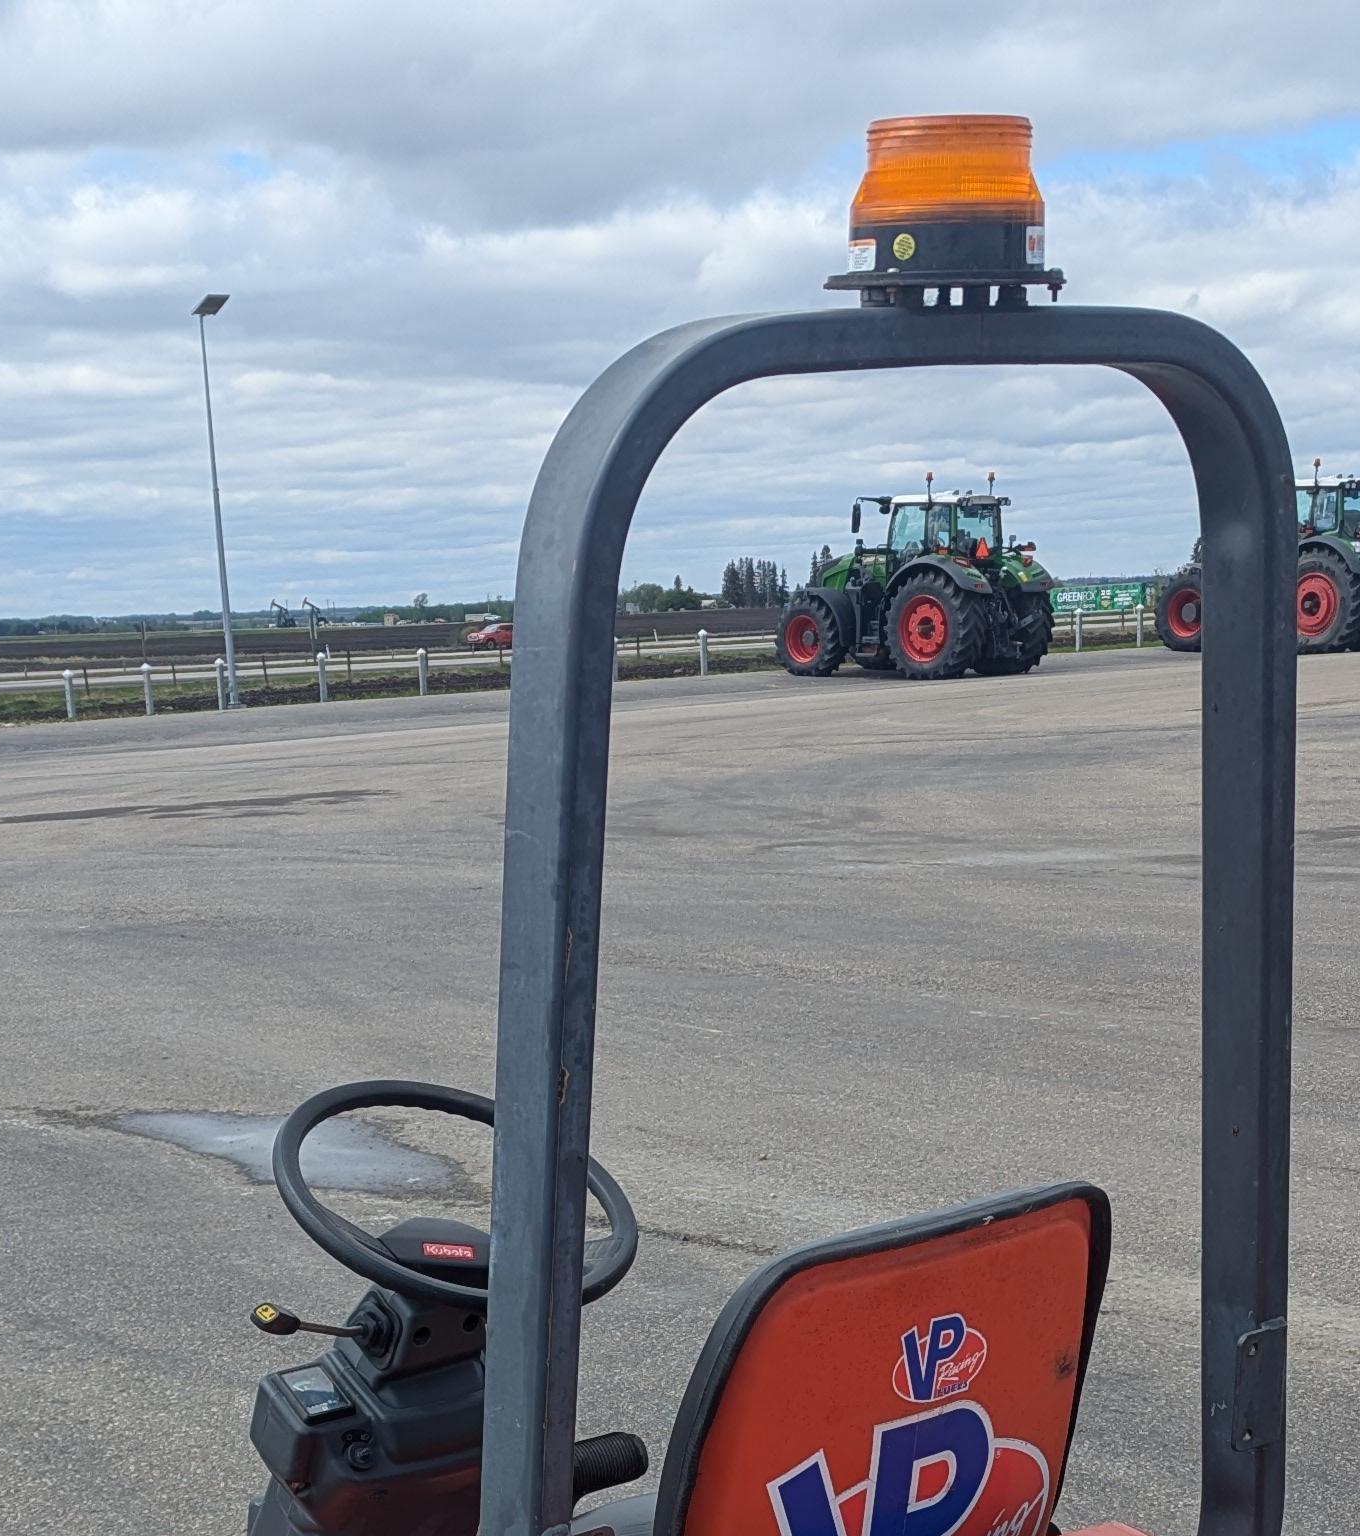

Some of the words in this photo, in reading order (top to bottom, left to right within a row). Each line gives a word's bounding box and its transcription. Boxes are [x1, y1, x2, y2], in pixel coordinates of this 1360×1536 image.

[1056, 590, 1097, 603] GREENFOX
[426, 1245, 472, 1258] Kubota
[901, 1313, 966, 1402] VP
[937, 1352, 980, 1389] Racing
[937, 1380, 968, 1397] FUELS
